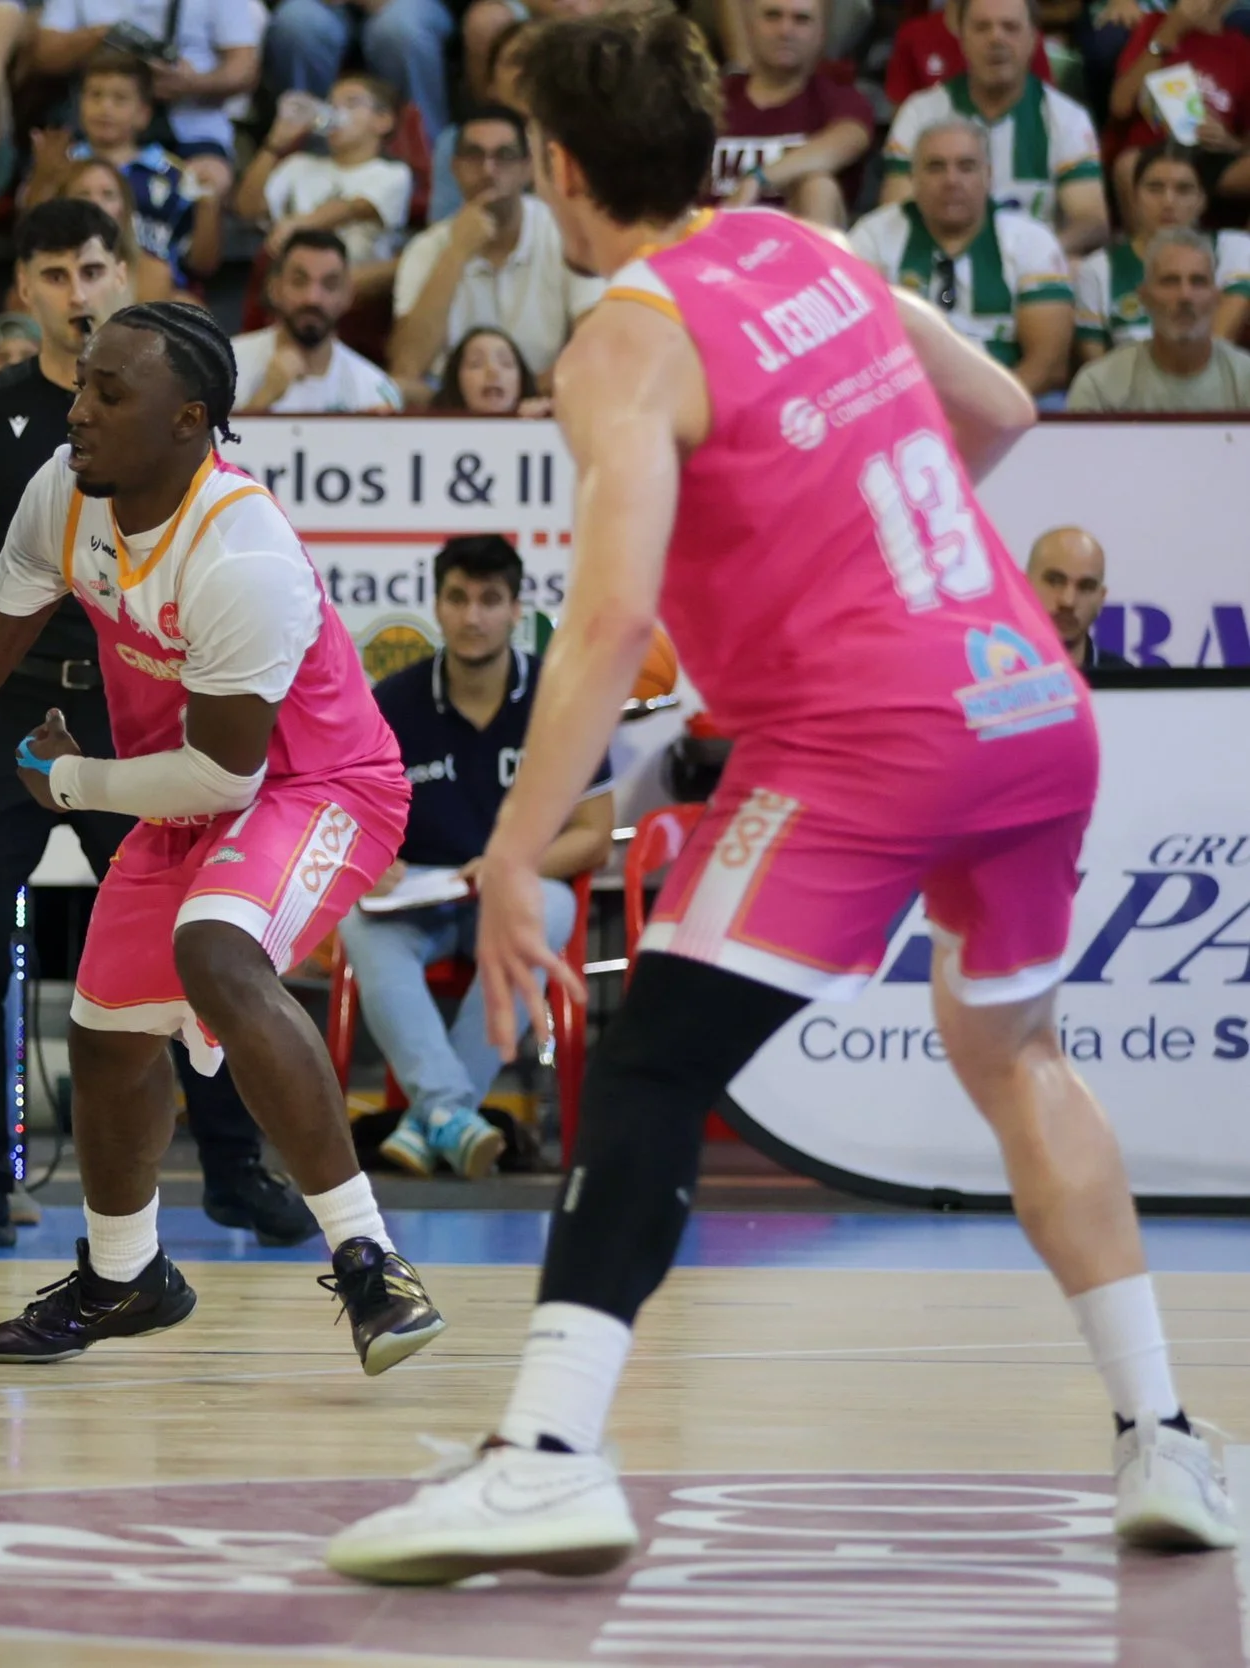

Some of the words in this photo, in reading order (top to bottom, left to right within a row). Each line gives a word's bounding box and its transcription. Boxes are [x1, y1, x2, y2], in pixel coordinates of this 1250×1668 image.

[763, 266, 874, 357] CEBOLLA
[240, 449, 387, 504] rlos
[411, 454, 423, 503] I
[448, 452, 496, 505] &
[519, 454, 553, 503] II
[857, 429, 994, 614] 13
[327, 560, 565, 605] tacies
[799, 1014, 1102, 1061] Correía
[1121, 1015, 1195, 1061] de
